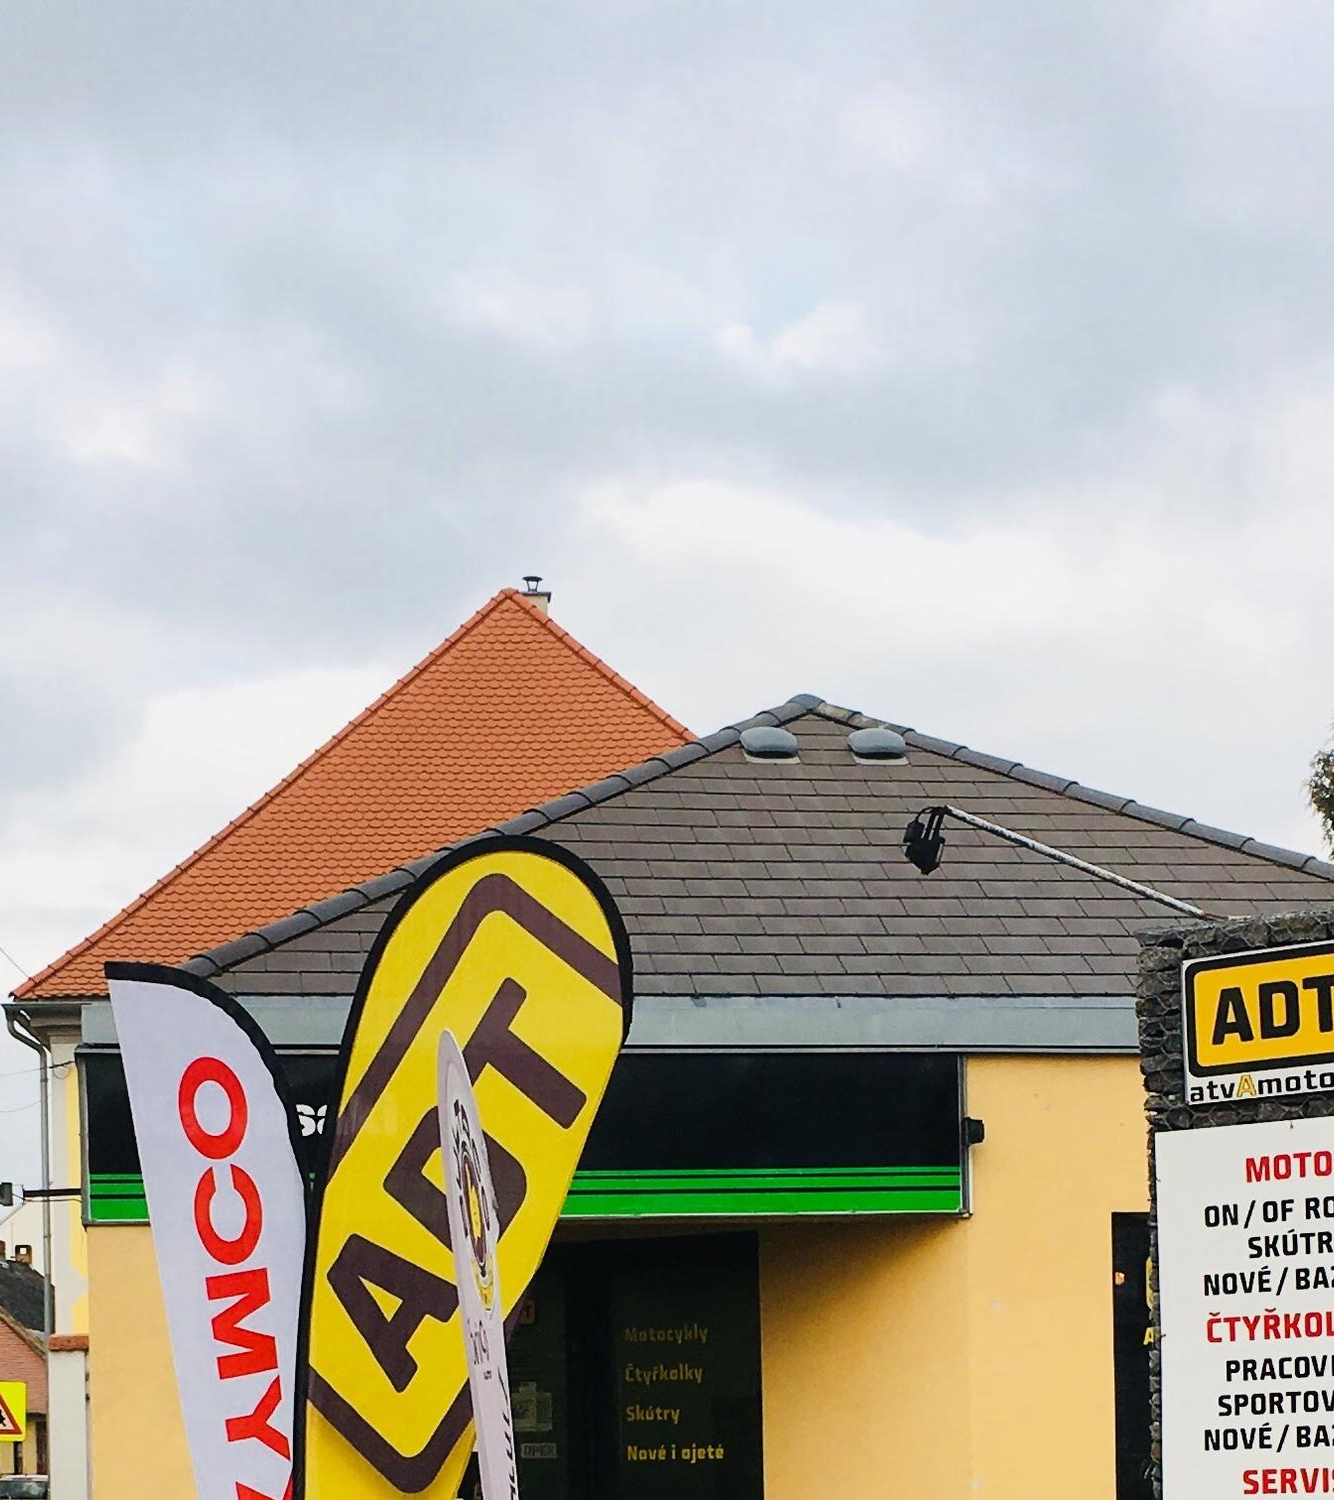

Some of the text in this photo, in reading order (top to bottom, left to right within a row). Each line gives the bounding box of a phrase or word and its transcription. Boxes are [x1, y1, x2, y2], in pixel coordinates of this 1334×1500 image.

[1245, 1150, 1333, 1184] MOTO
[327, 977, 587, 1393] ADT
[1247, 1228, 1334, 1259] SKÚTR
[625, 1323, 708, 1345] Motocykly
[625, 1363, 703, 1385] Čtyřkolky
[626, 1404, 681, 1424] Skútry
[627, 1443, 725, 1464] Nové i ojeté
